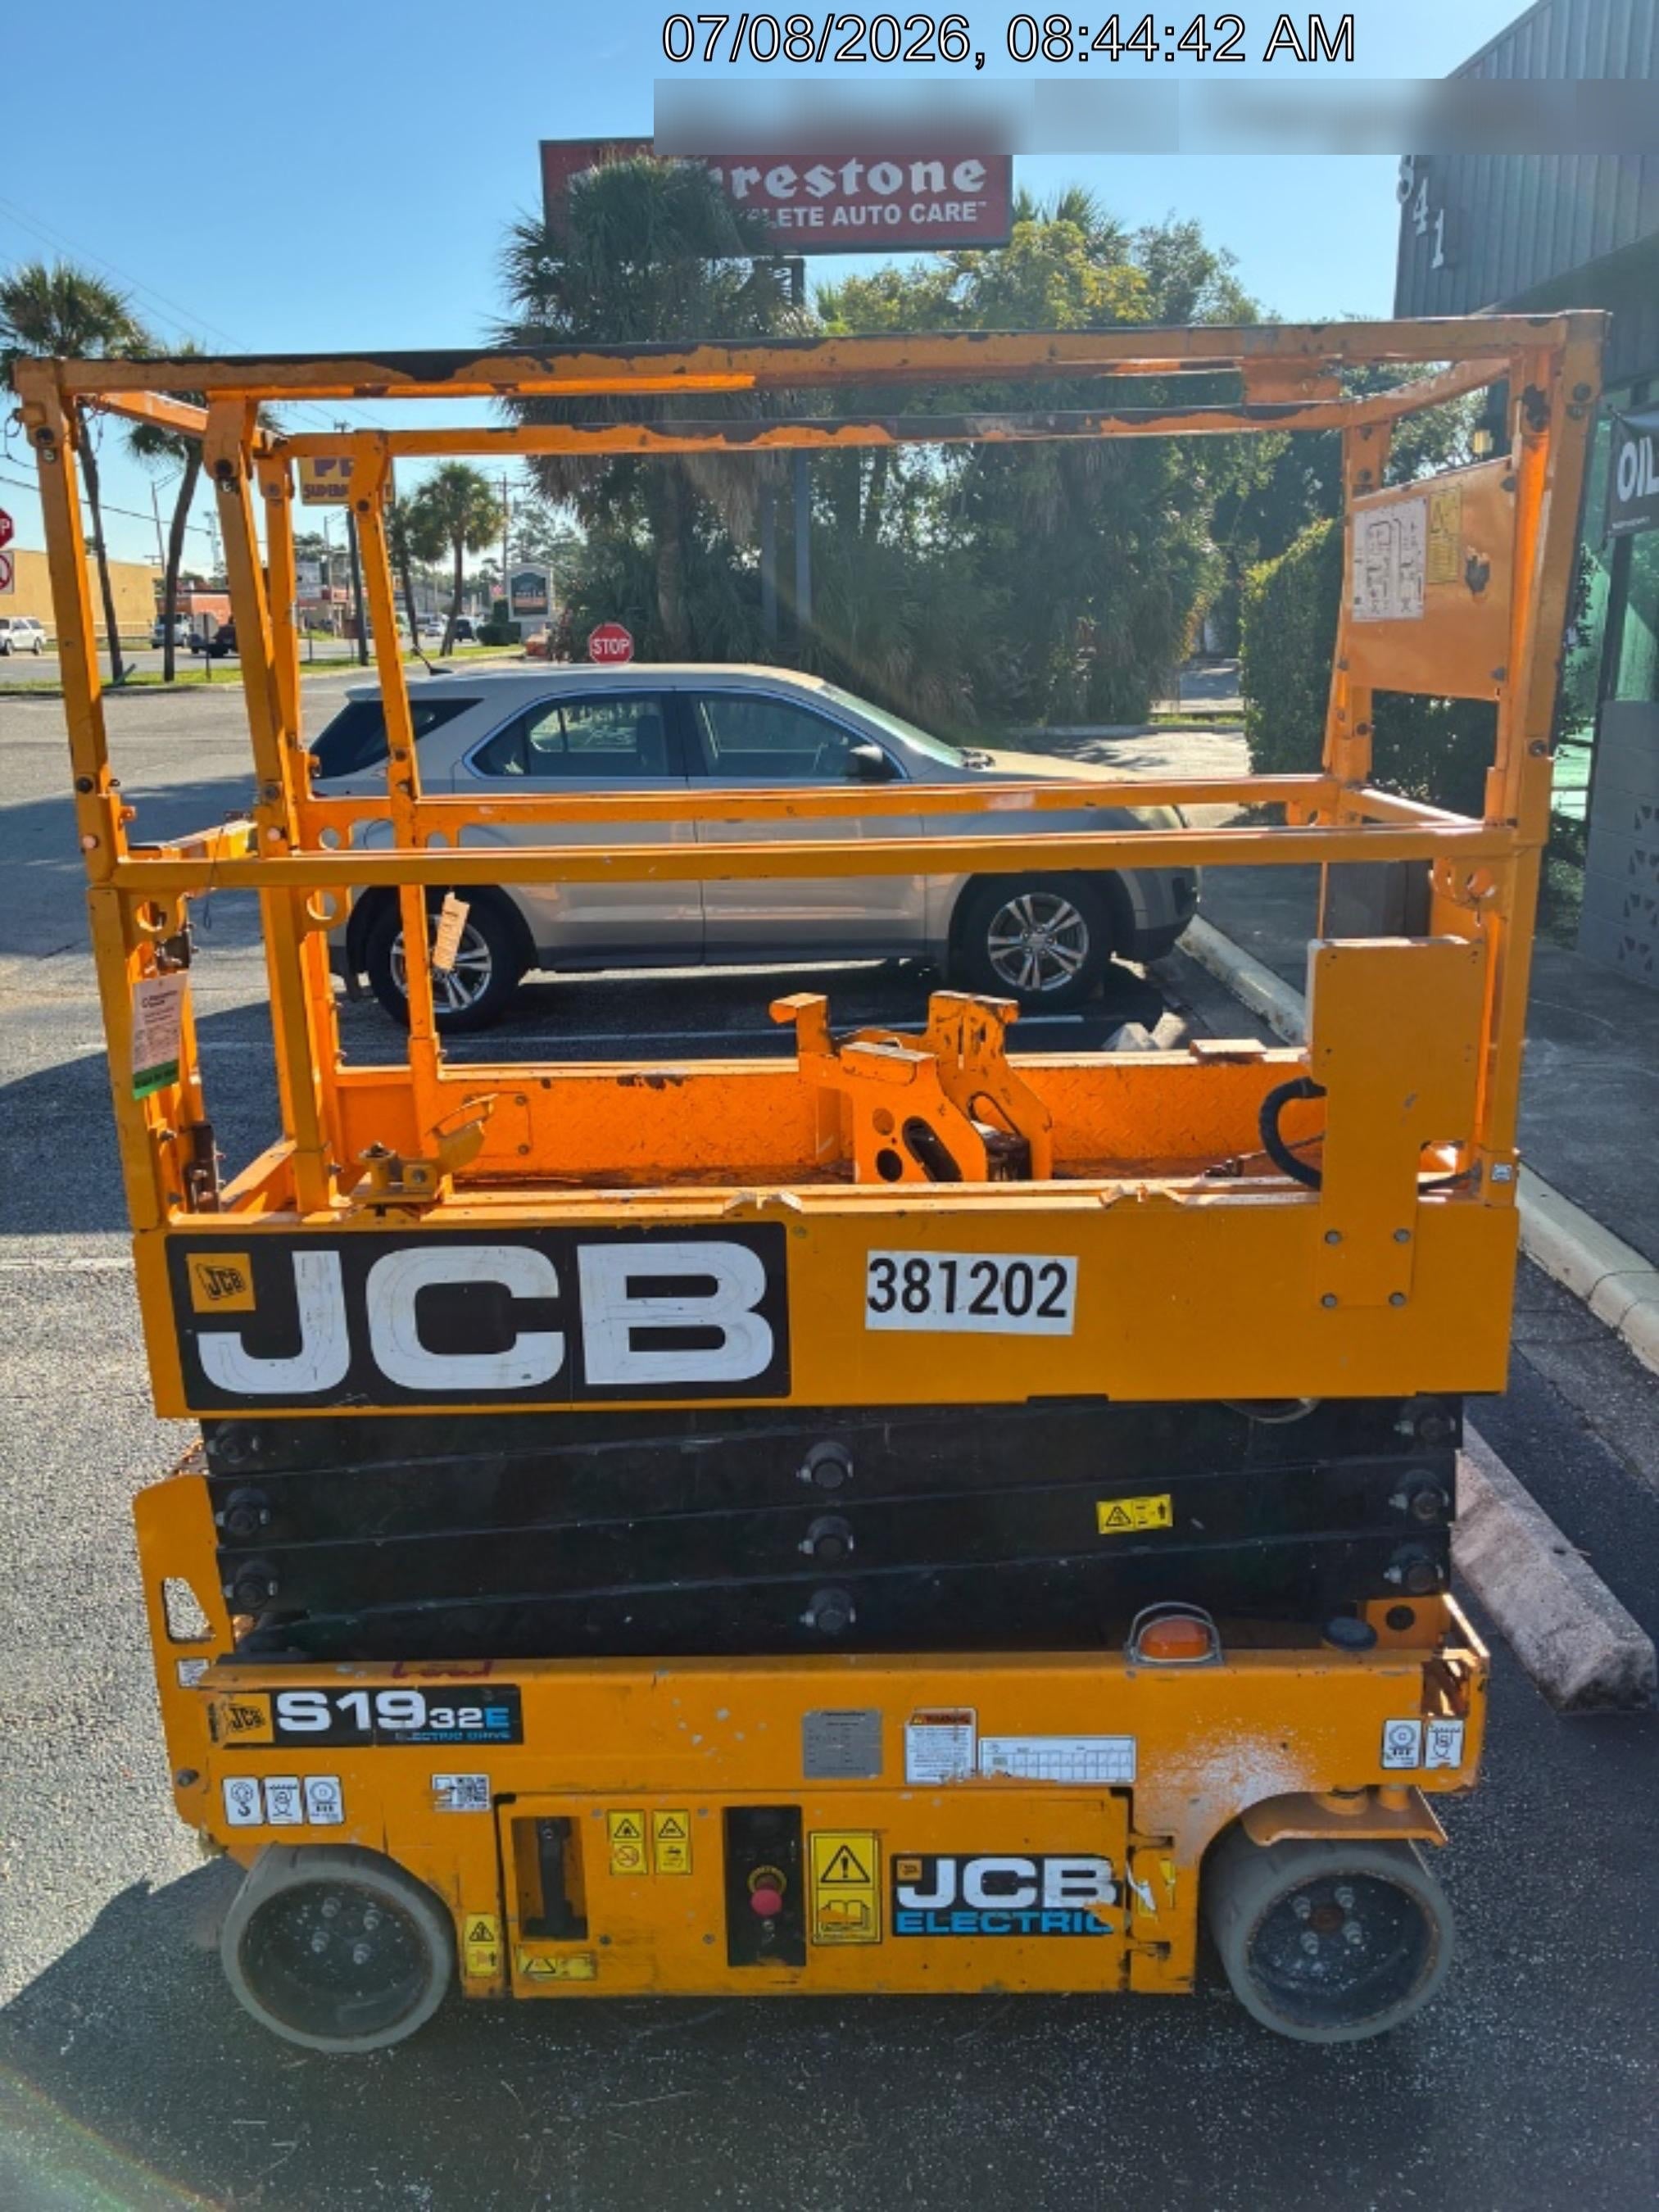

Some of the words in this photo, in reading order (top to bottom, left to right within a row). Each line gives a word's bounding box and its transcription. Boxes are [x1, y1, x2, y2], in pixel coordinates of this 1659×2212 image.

[707, 157, 987, 200] restone
[832, 204, 900, 225] AUTO
[909, 202, 977, 223] CARE
[1617, 436, 1659, 502] OIL
[593, 639, 630, 655] STOP
[198, 1264, 246, 1299] JCB
[867, 1258, 1067, 1317] 381202
[197, 1241, 774, 1394] JCB
[897, 1857, 1117, 1908] JCB
